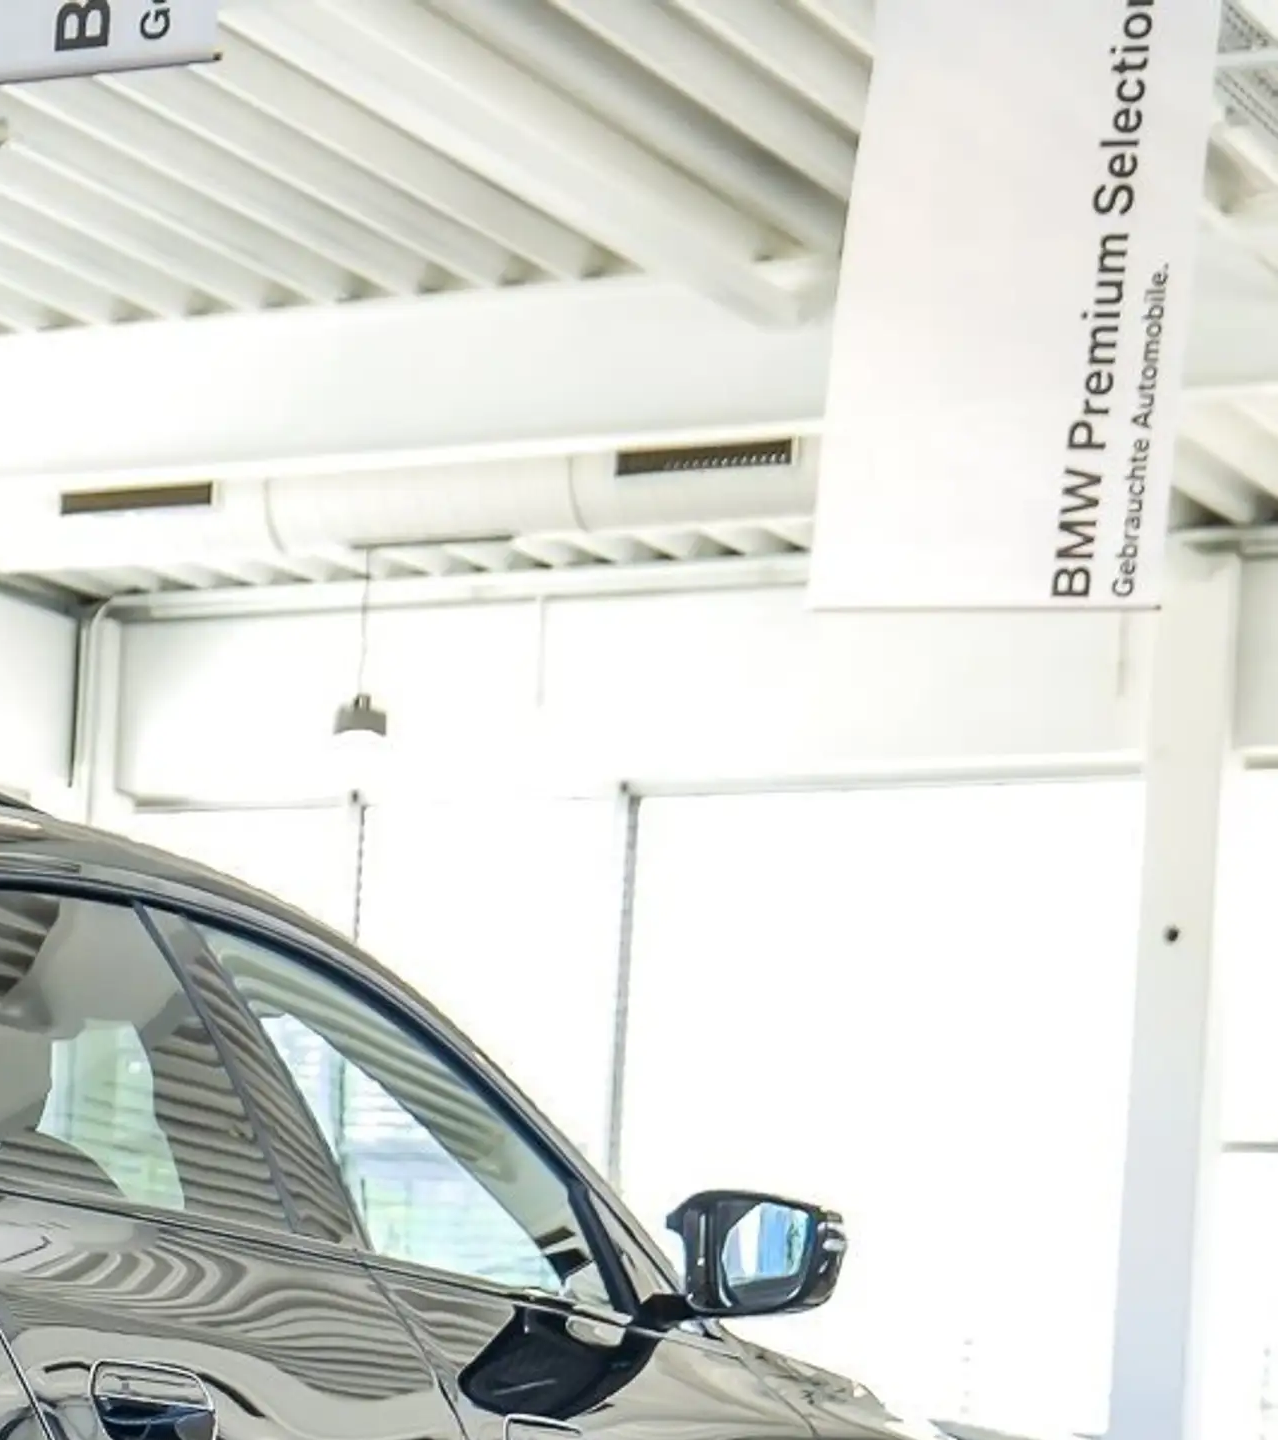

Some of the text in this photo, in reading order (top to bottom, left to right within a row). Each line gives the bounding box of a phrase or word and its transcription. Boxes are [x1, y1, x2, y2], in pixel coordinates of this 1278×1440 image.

[1067, 232, 1130, 451] Premium
[1111, 262, 1170, 598] Gebrauchte Automobile.
[1050, 467, 1103, 599] BMW
